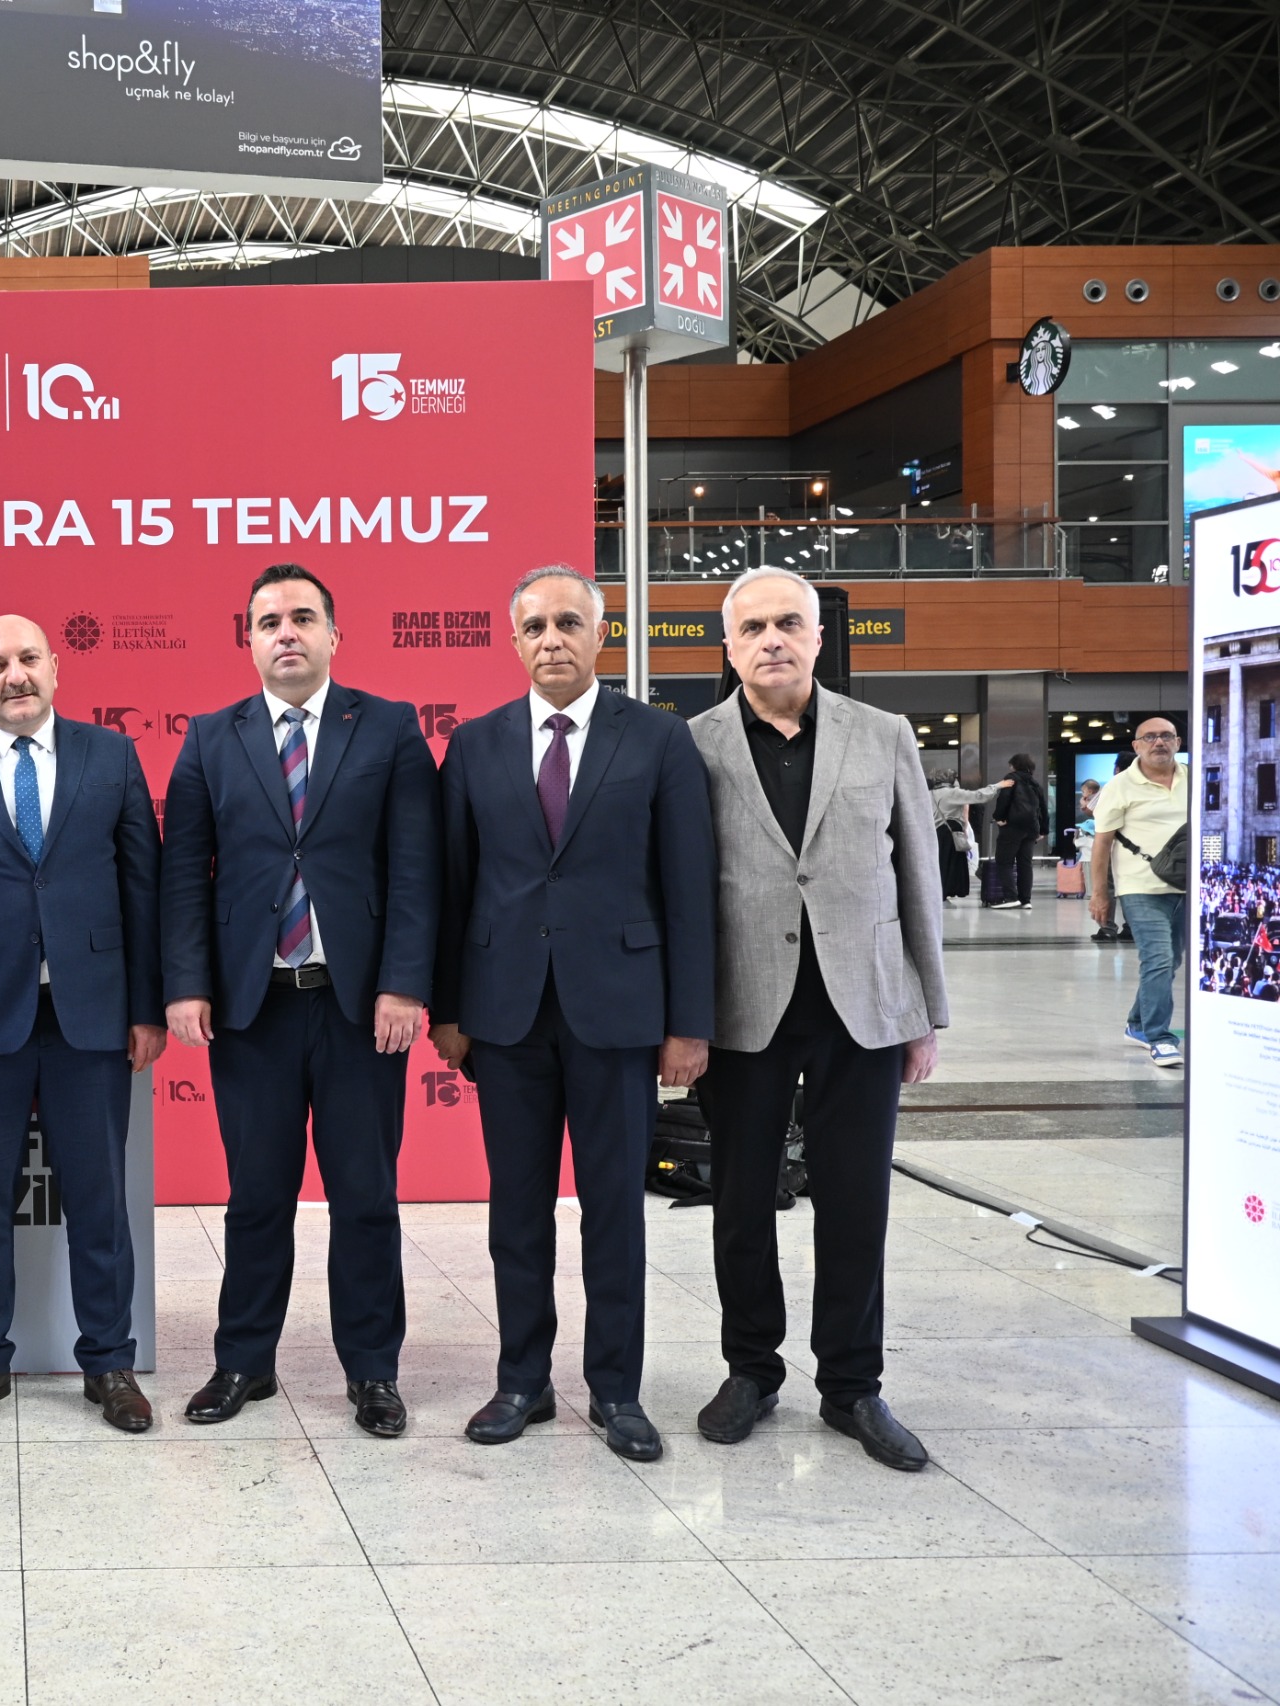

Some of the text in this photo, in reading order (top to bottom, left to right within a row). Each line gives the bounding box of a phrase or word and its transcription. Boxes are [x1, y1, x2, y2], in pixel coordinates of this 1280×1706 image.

[67, 34, 196, 86] shop&fly
[125, 85, 235, 106] uçmak ne kolay!
[238, 131, 326, 146] Bilgi ve başvuru için
[238, 142, 324, 159] shopandfly.com.tr
[547, 172, 644, 215] MEETING POINT
[677, 314, 705, 336] DOĞU
[331, 353, 407, 421] 15
[409, 378, 465, 395] TEMMUZ
[111, 499, 174, 546] 15
[192, 494, 489, 545] TEMMUZ
[392, 611, 491, 629] İRADE BİZİM
[112, 626, 166, 640] İLETİŞİM
[392, 630, 491, 648] ZAFER BİZİM
[112, 637, 186, 651] BAŞKANLIĞI
[421, 1071, 461, 1107] 15
